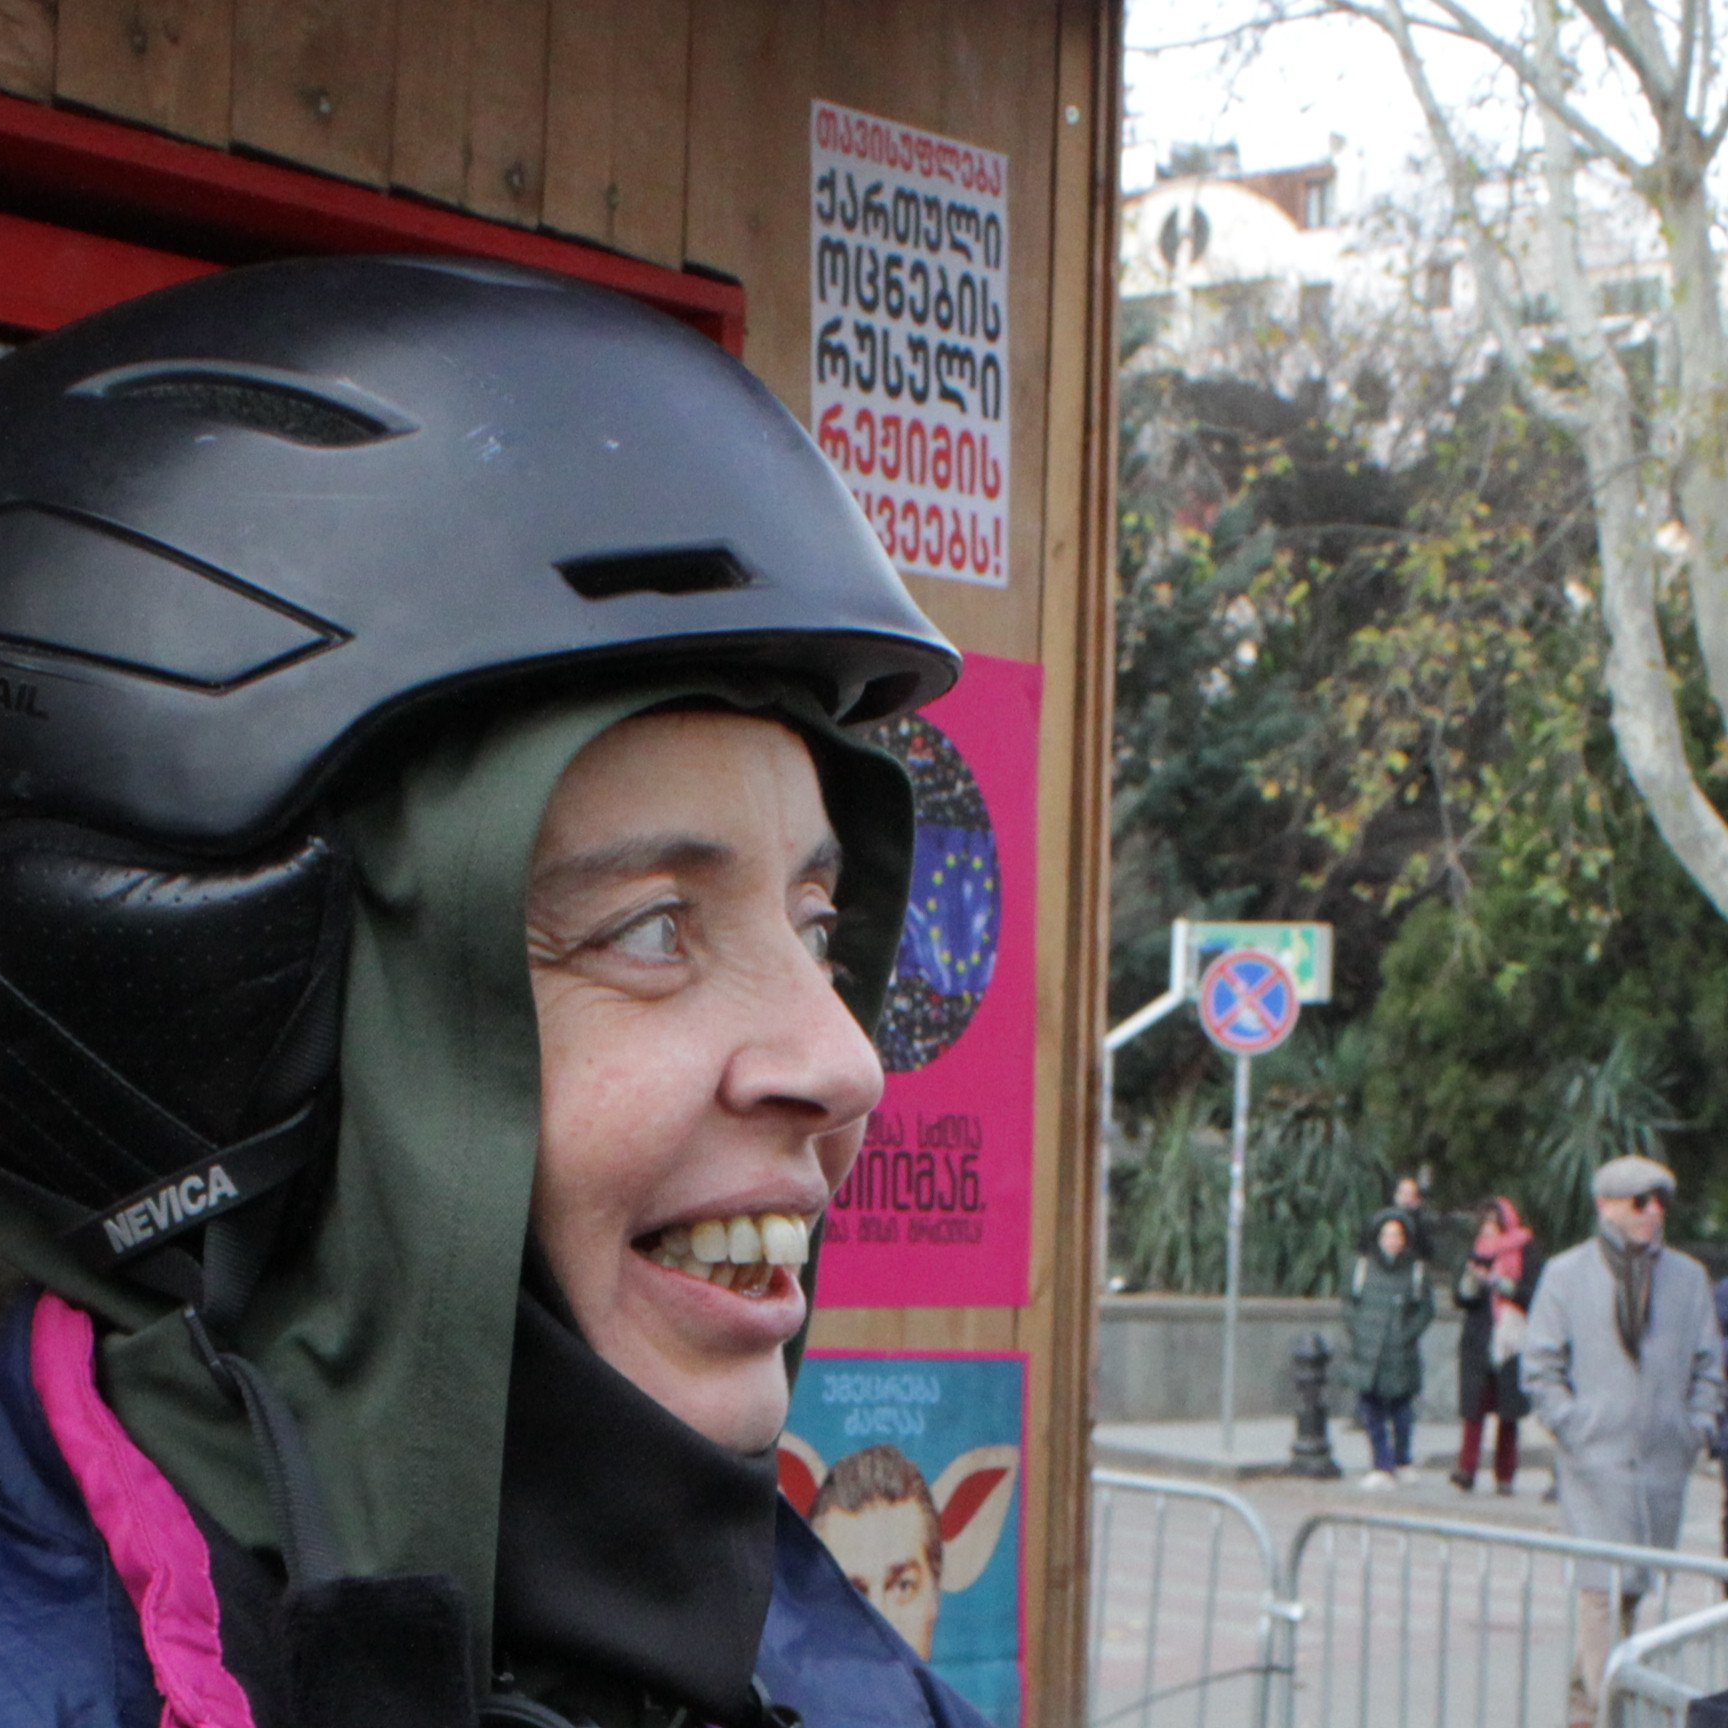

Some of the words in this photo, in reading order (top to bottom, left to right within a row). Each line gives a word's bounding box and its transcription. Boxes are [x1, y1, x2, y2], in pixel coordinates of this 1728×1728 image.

[816, 107, 1002, 197] თავისუფლება
[816, 167, 1002, 269] ქართული
[818, 235, 1002, 343] ოცნების
[817, 314, 1002, 421] რუსული
[817, 402, 1002, 499] რეჟიმის
[102, 1163, 240, 1255] NEVICA
